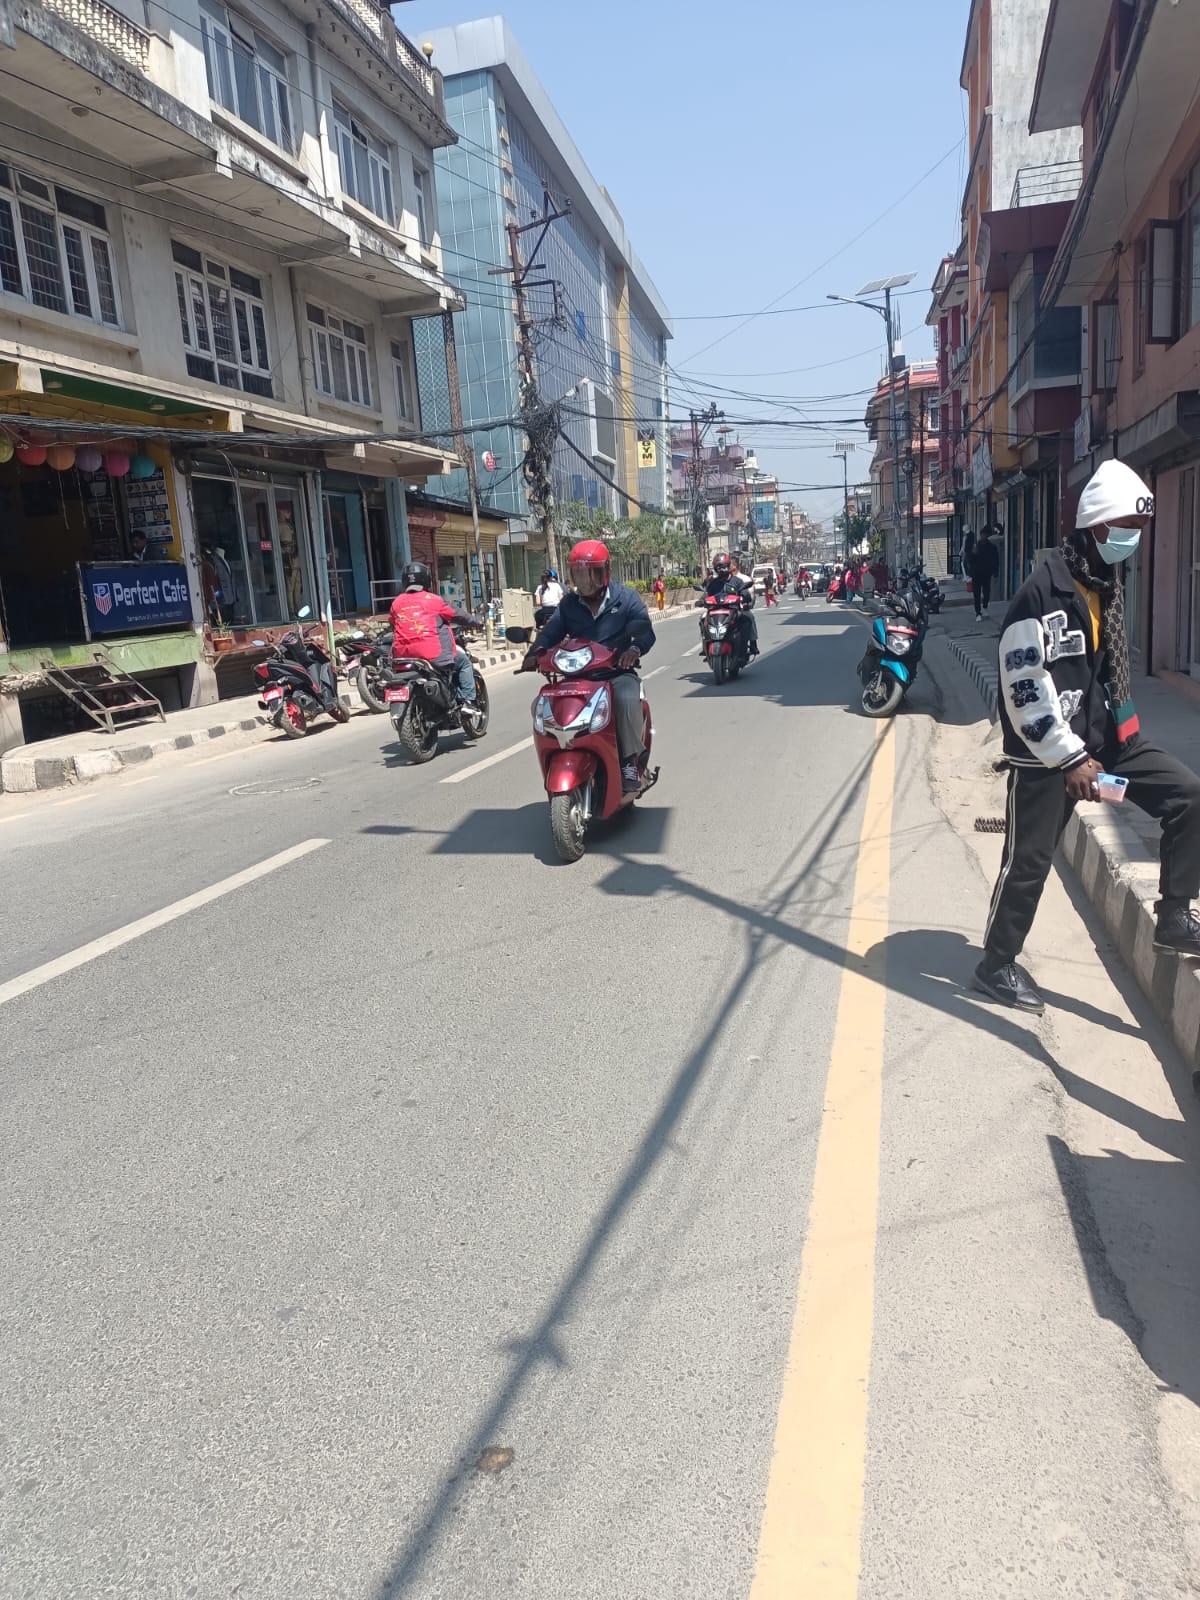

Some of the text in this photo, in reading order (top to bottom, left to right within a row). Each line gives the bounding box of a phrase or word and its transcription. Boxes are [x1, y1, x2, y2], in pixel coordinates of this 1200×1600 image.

[642, 441, 652, 459] GYM
[112, 579, 187, 606] Perfect Cafe
[1042, 610, 1086, 662] L
